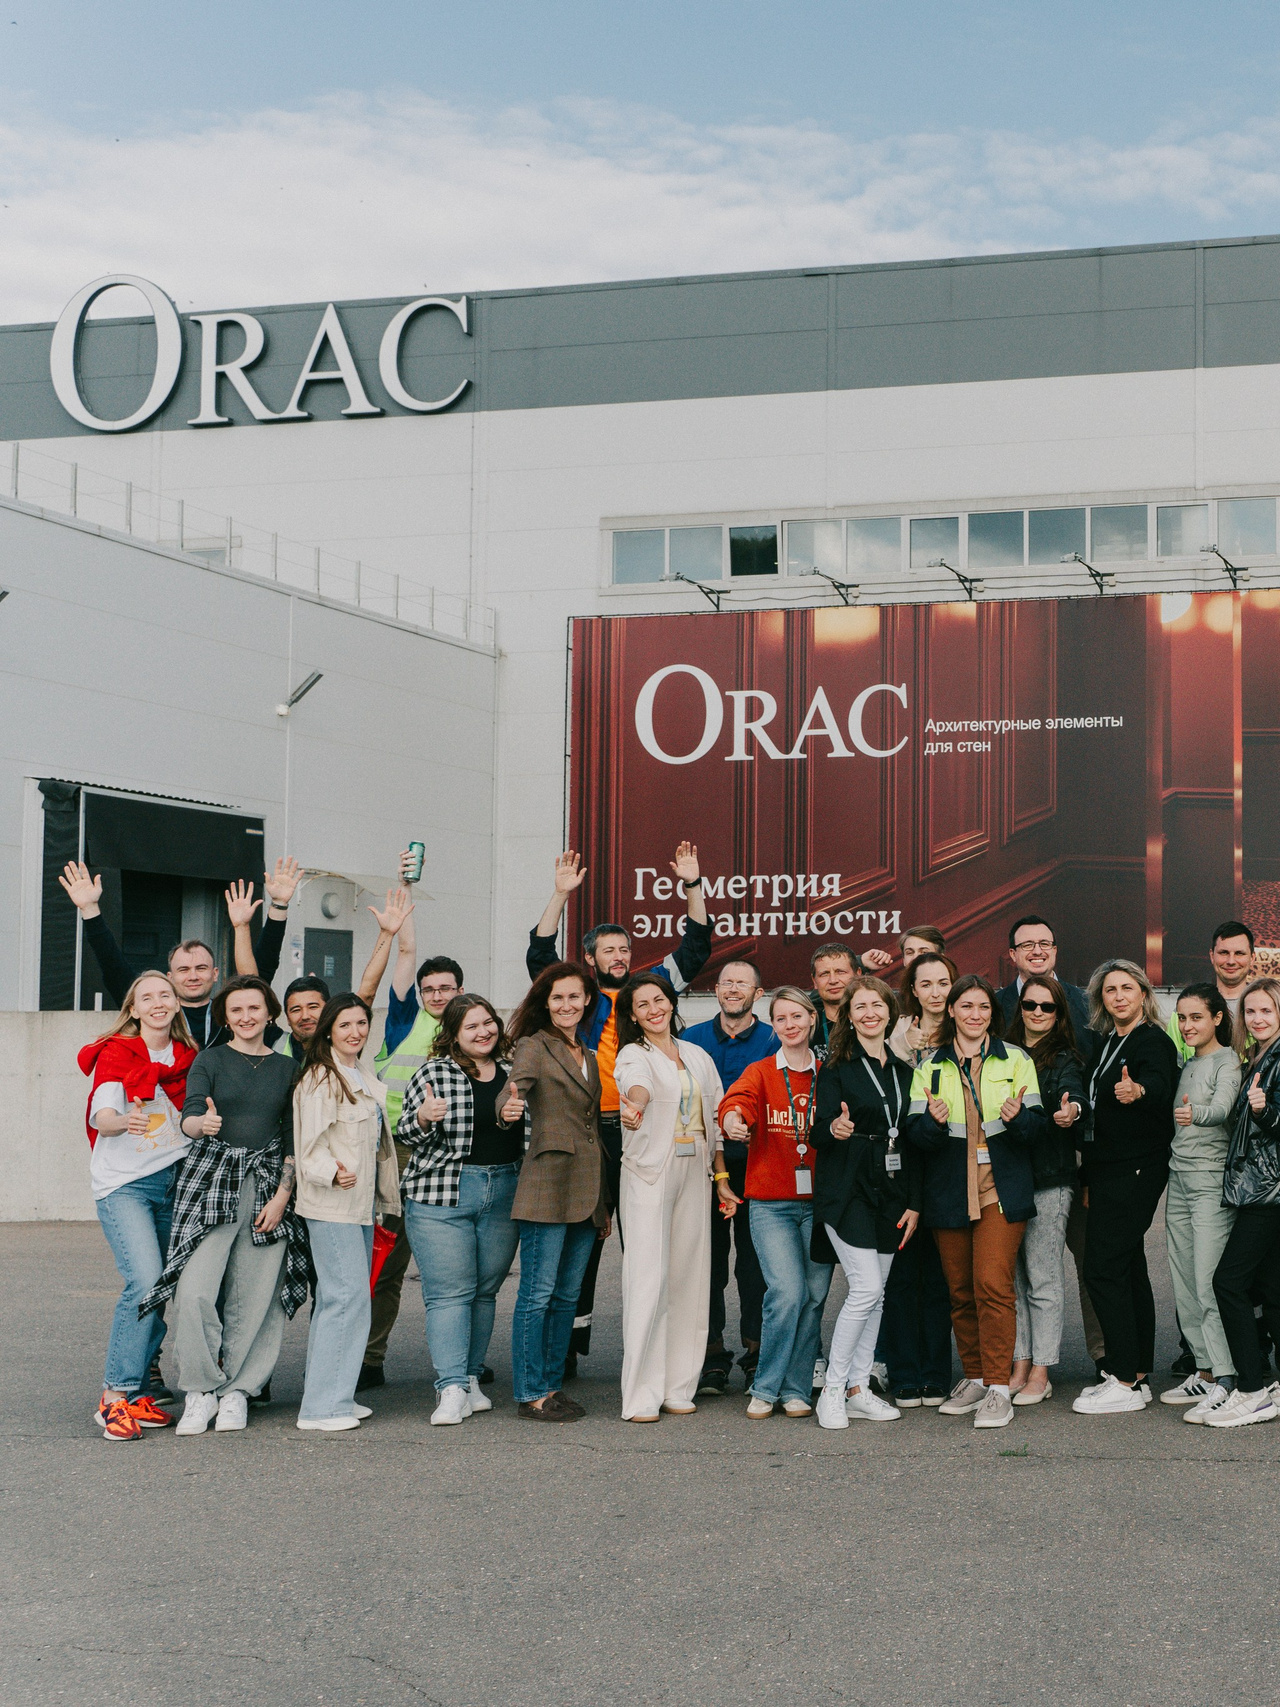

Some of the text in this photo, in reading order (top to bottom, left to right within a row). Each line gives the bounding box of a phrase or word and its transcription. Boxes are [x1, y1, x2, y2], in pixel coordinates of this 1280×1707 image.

[49, 273, 473, 433] ORAC
[634, 663, 909, 765] ORAC
[924, 715, 1124, 735] Архитектурные элементы
[924, 740, 991, 756] для стен
[632, 910, 902, 938] элеантности
